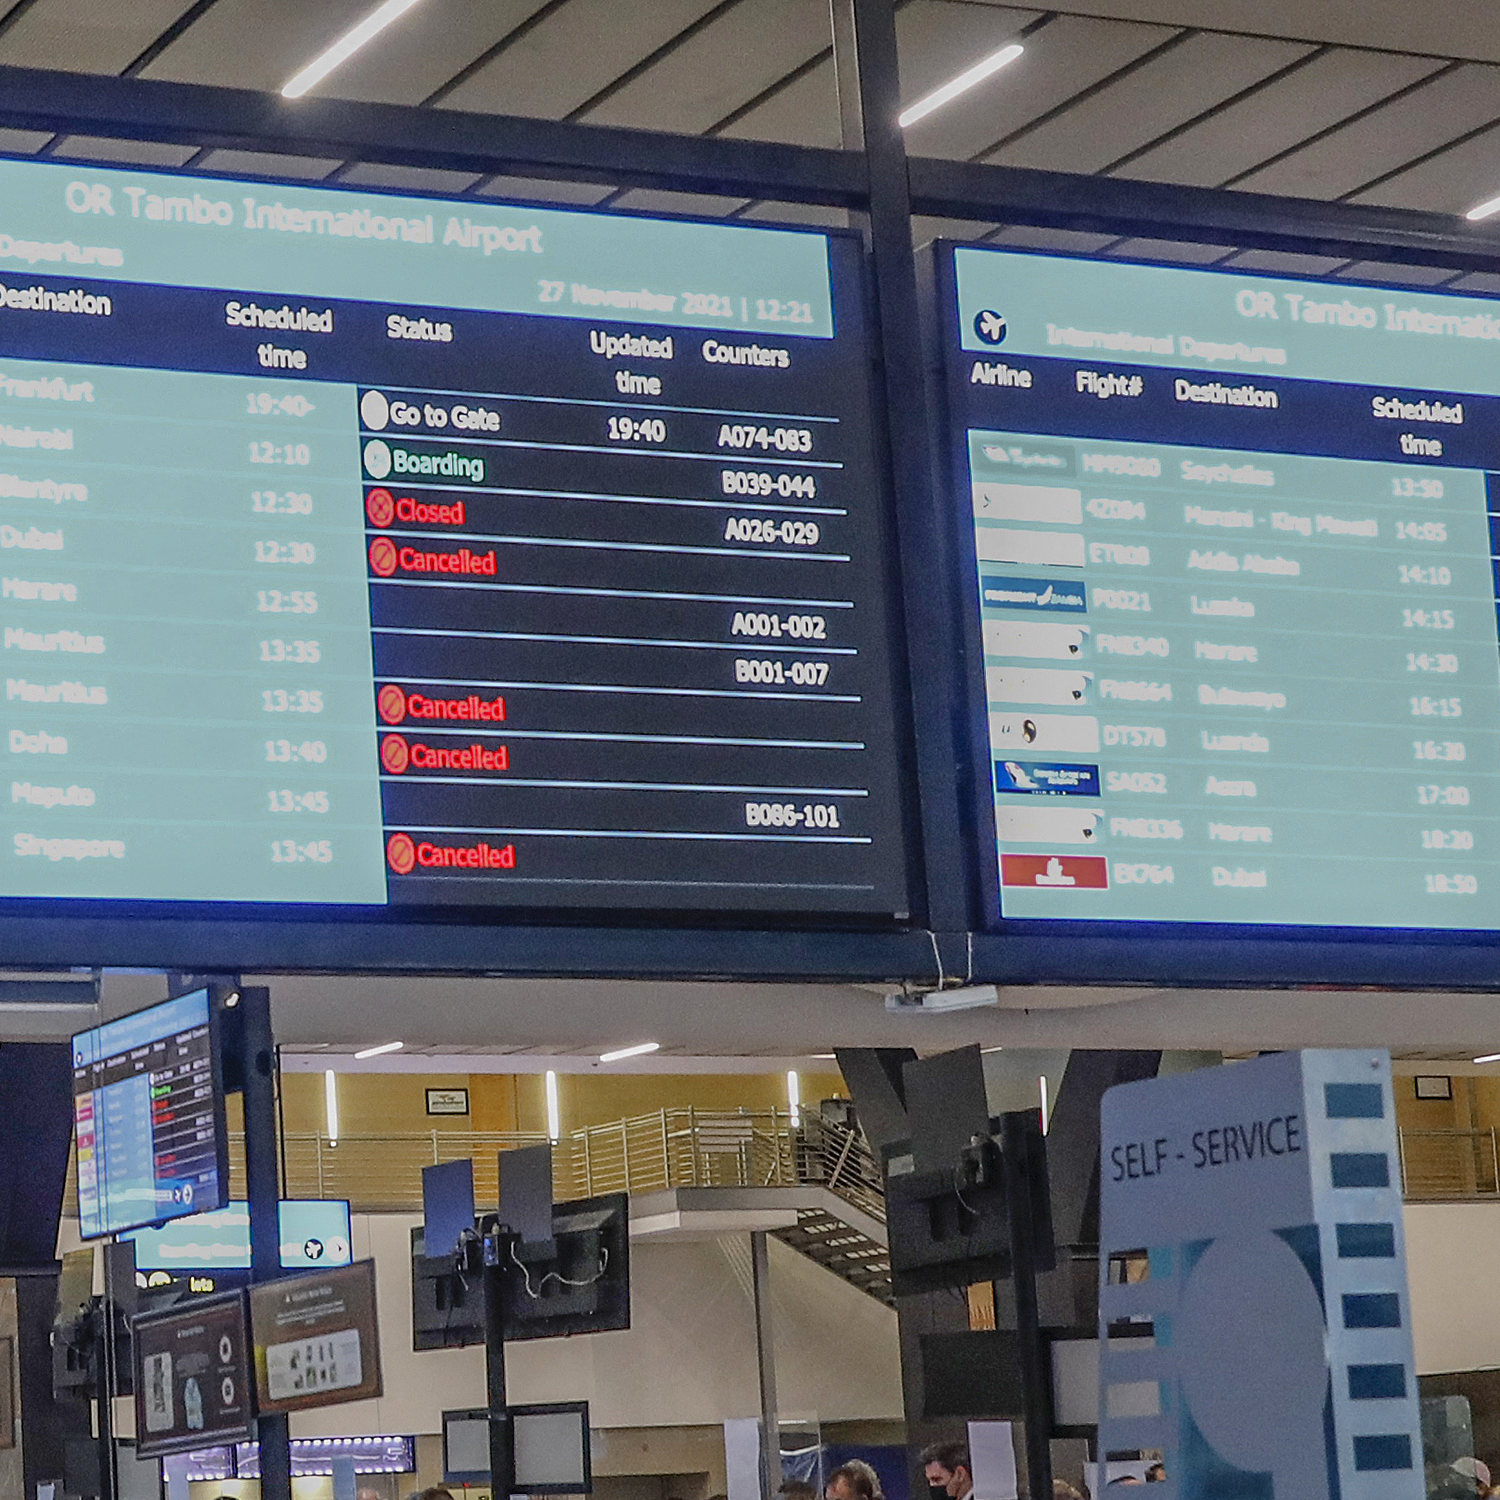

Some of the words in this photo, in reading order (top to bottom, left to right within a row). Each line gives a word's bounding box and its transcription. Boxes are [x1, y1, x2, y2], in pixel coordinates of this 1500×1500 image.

[67, 182, 115, 215] OR
[123, 187, 233, 225] Tambo
[243, 198, 433, 243] International
[444, 218, 542, 255] Airport
[540, 280, 564, 302] 27
[572, 284, 676, 311] November
[683, 293, 732, 316] 2021
[757, 300, 812, 322] 12:21
[1237, 290, 1278, 319] OR
[1285, 294, 1376, 328] Tambo
[226, 302, 332, 332] Scheduled
[388, 315, 452, 341] Status
[591, 331, 672, 358] Updated
[703, 340, 789, 367] Counters
[258, 344, 306, 369] time
[616, 371, 660, 395] time
[971, 362, 1031, 387] Airline
[1077, 371, 1142, 398] Flight#
[1176, 380, 1277, 408] Destination
[1373, 397, 1462, 423] Scheduled
[390, 402, 420, 425] Go
[424, 404, 447, 427] to
[451, 406, 499, 431] Gate
[609, 417, 665, 442] 19:40
[719, 425, 811, 452] A074-083
[1400, 434, 1442, 456] time
[251, 442, 309, 465] 12:10
[394, 450, 483, 481] Boarding
[723, 471, 815, 498] B039-044
[395, 498, 466, 526] Closed
[725, 518, 818, 544] A026-029
[399, 547, 497, 576] Cancelled
[732, 613, 826, 639] A001-002
[736, 660, 828, 685] B001-007
[407, 694, 507, 722] Cancelled
[409, 743, 509, 771] Cancelled
[746, 803, 839, 827] B086-101
[416, 842, 516, 869] Cancelled
[1111, 1136, 1168, 1182] SELF
[1191, 1114, 1301, 1170] SERVICE
